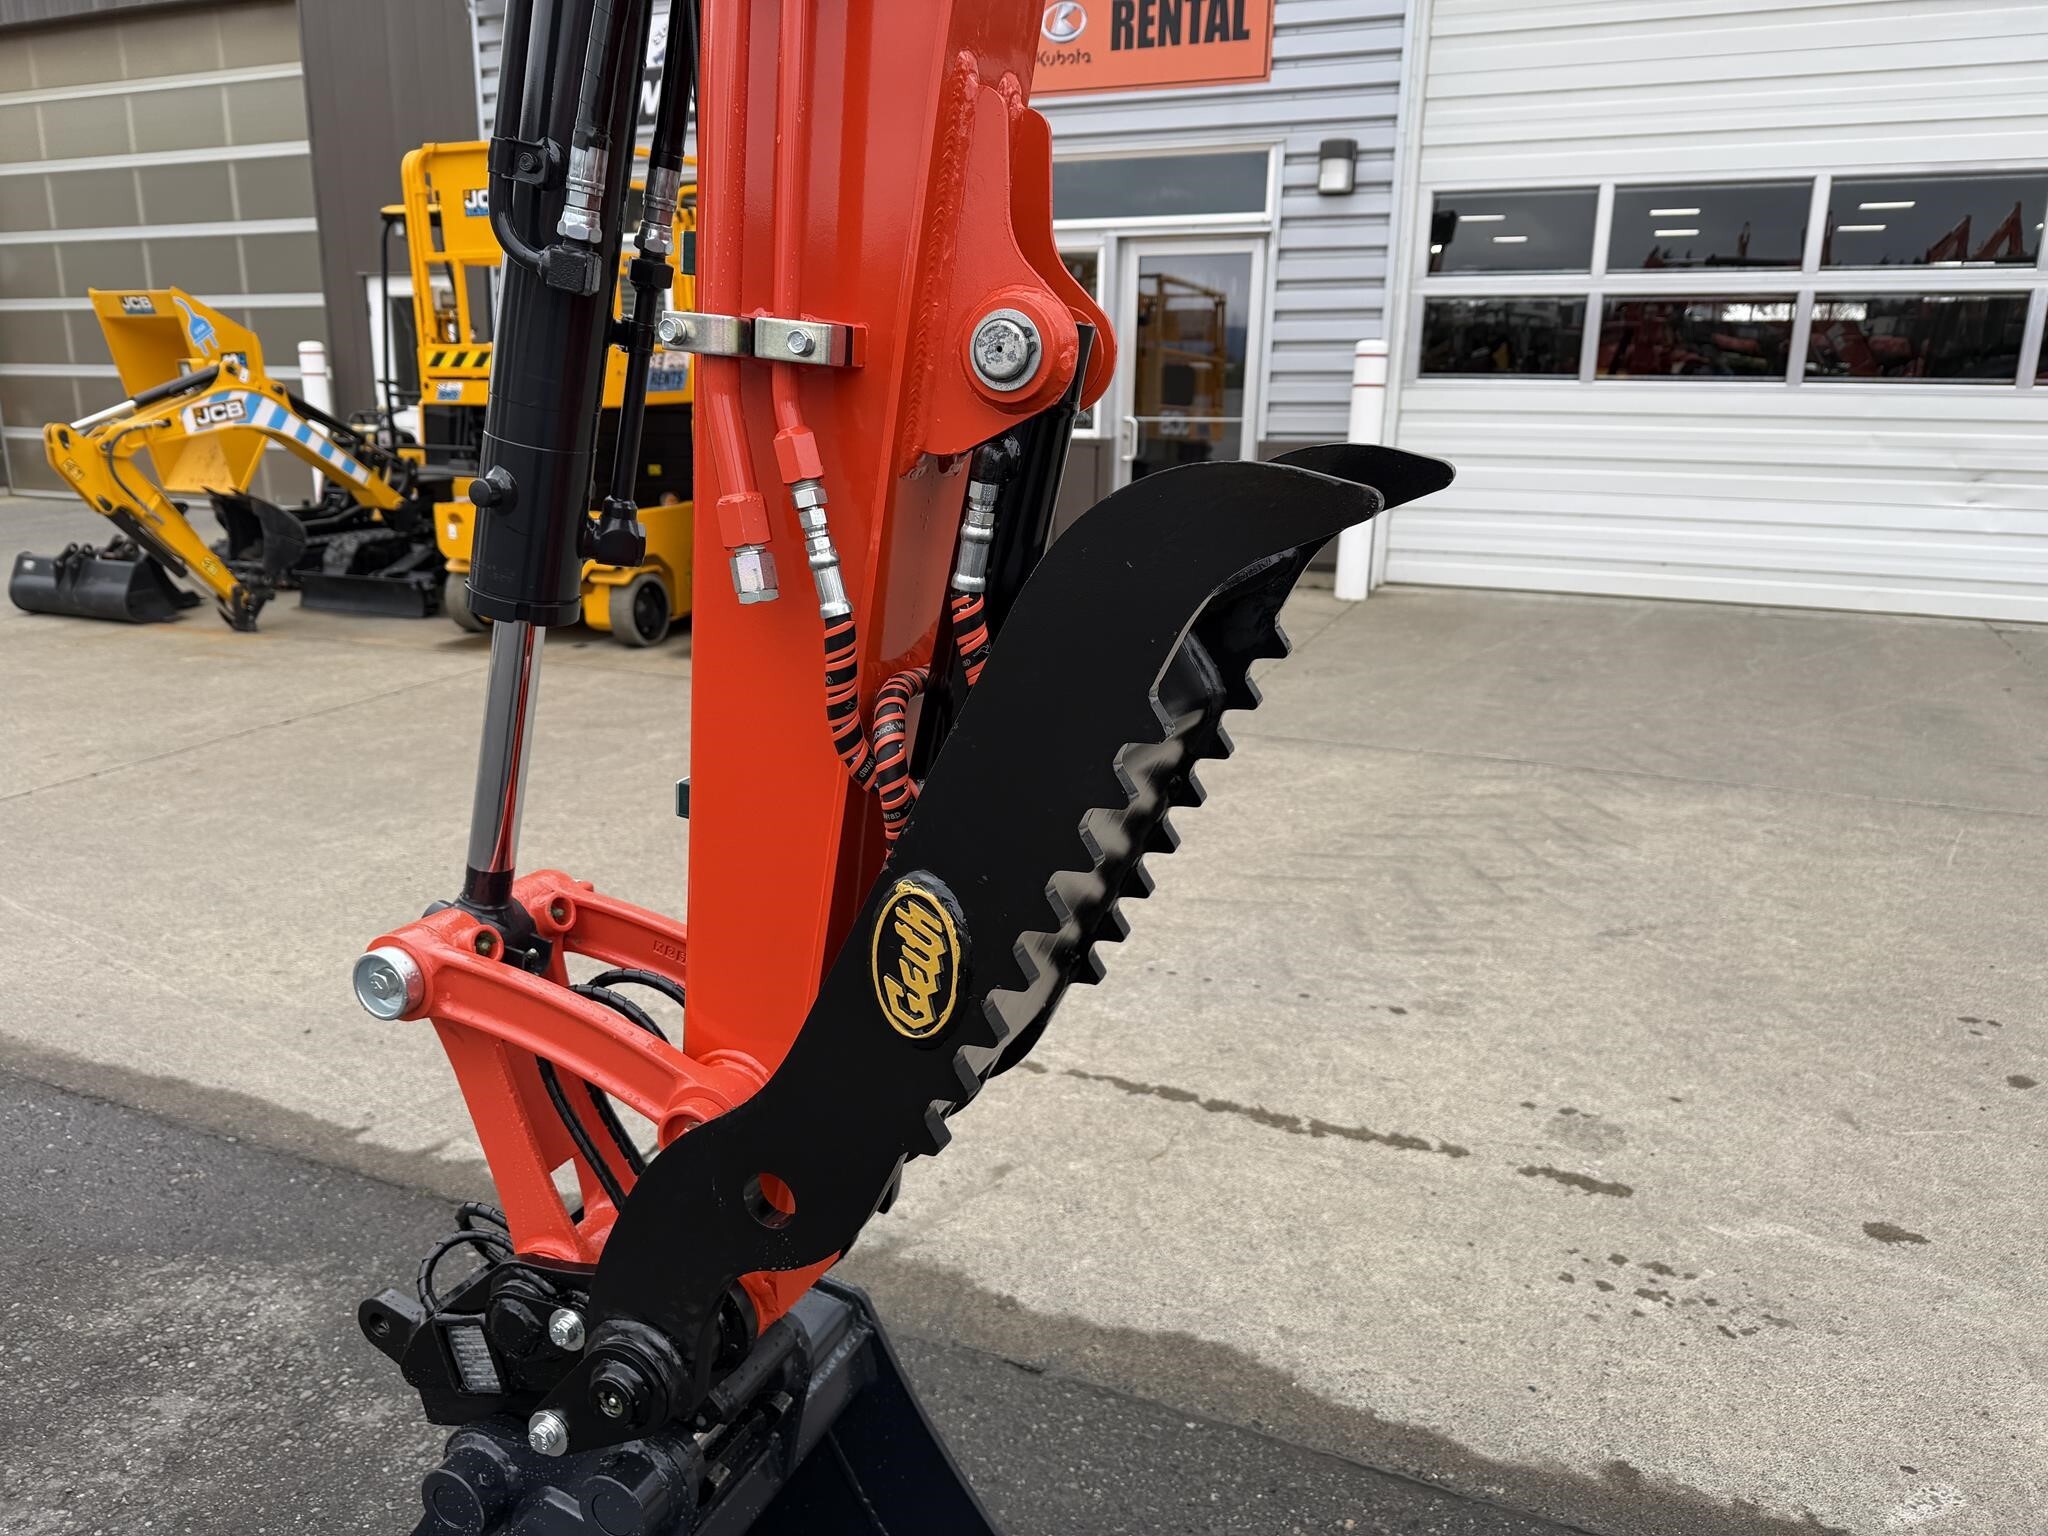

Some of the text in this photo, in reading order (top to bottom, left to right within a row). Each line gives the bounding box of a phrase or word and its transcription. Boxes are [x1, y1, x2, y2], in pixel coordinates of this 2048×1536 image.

[1111, 0, 1250, 51] RENTAL
[464, 190, 489, 208] JC
[122, 297, 153, 309] JCB
[196, 401, 244, 424] JCB
